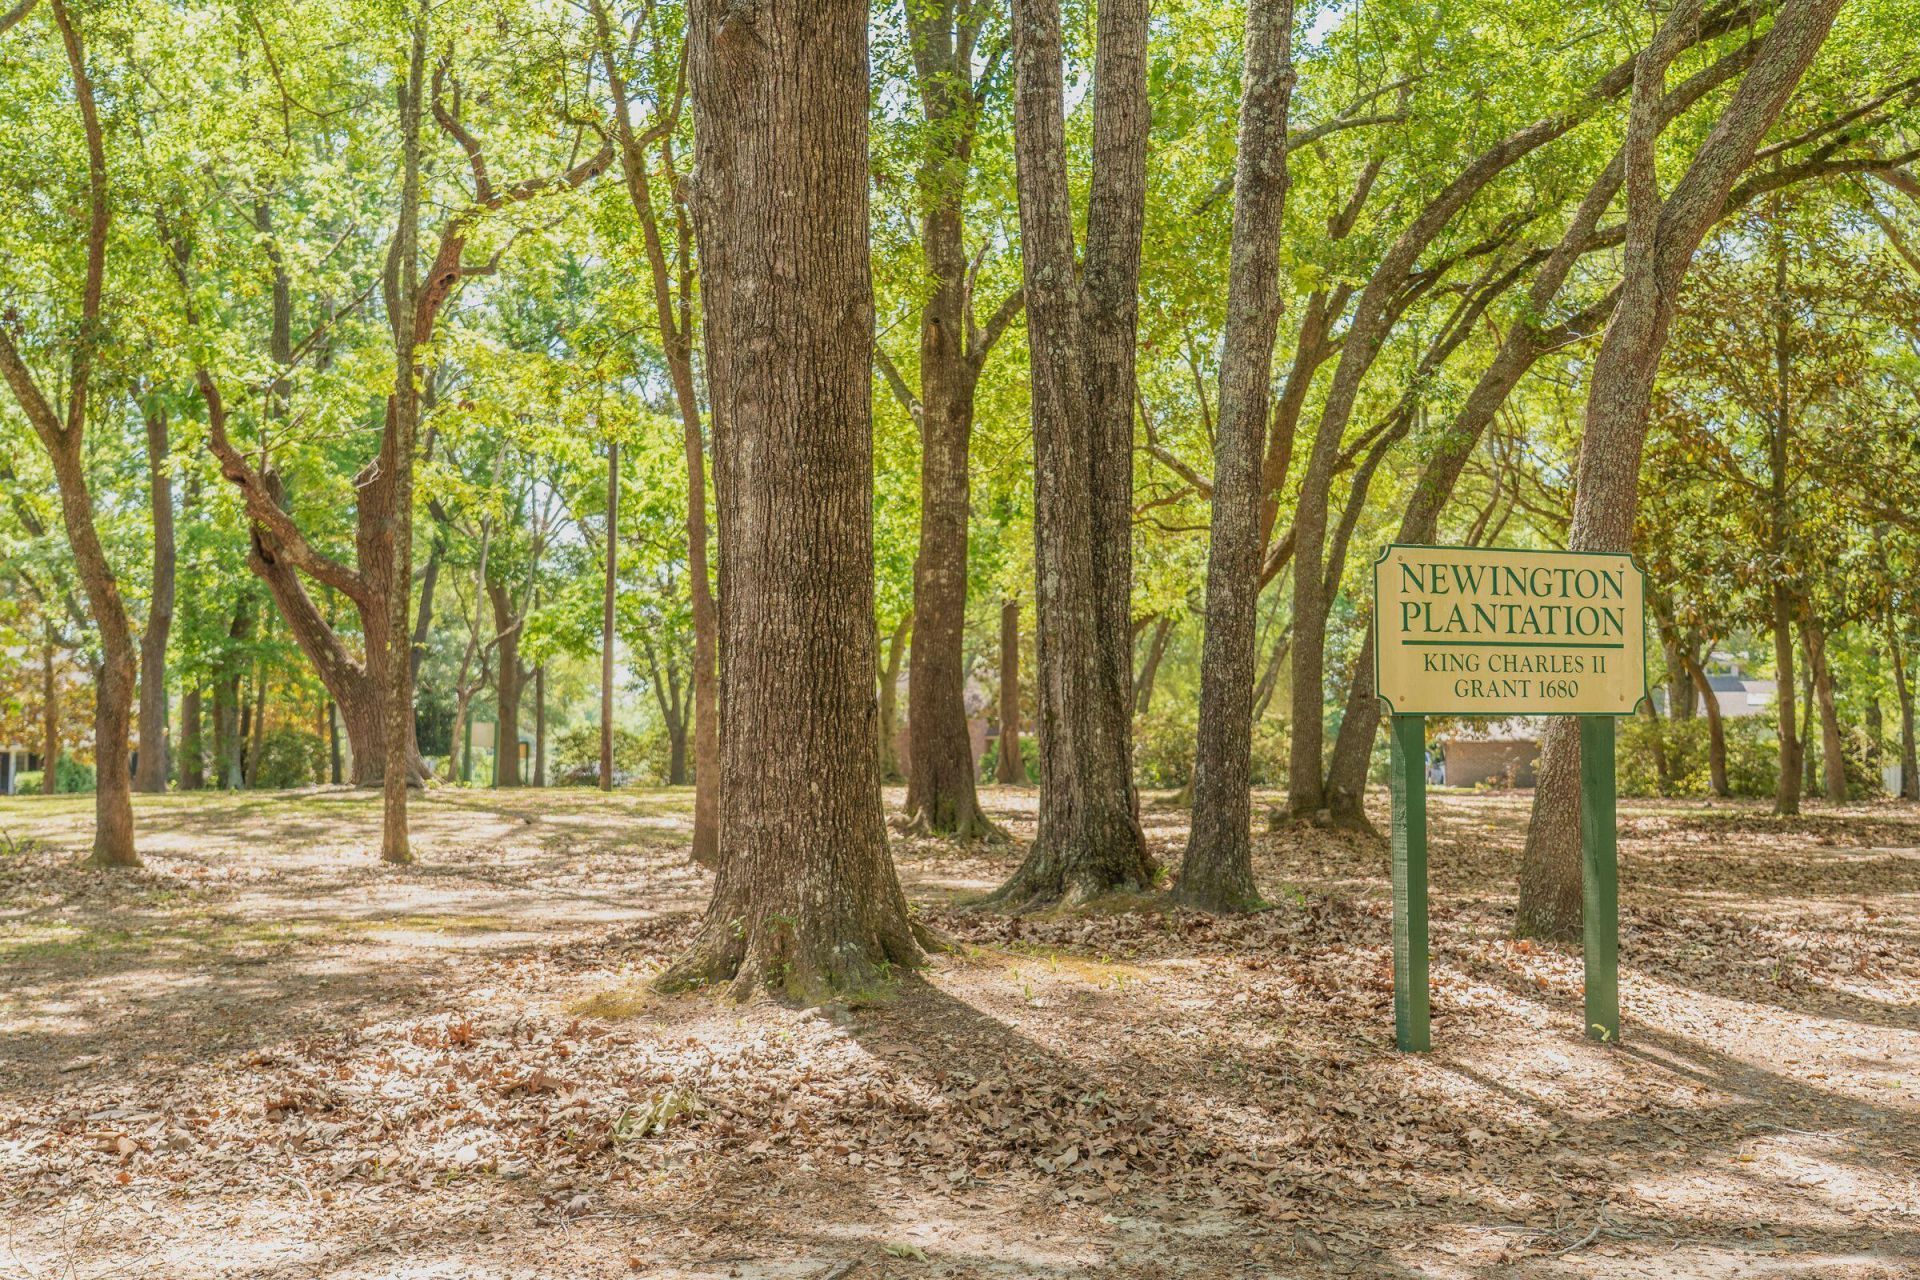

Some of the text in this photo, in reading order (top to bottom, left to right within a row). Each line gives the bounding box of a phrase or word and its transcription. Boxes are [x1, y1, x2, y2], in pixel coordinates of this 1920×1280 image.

[1399, 562, 1625, 600] NEWINGTON
[1400, 601, 1625, 636] PLANTATION
[1424, 653, 1607, 674] KING CHARLES II
[1454, 679, 1579, 698] GRANT 1680
